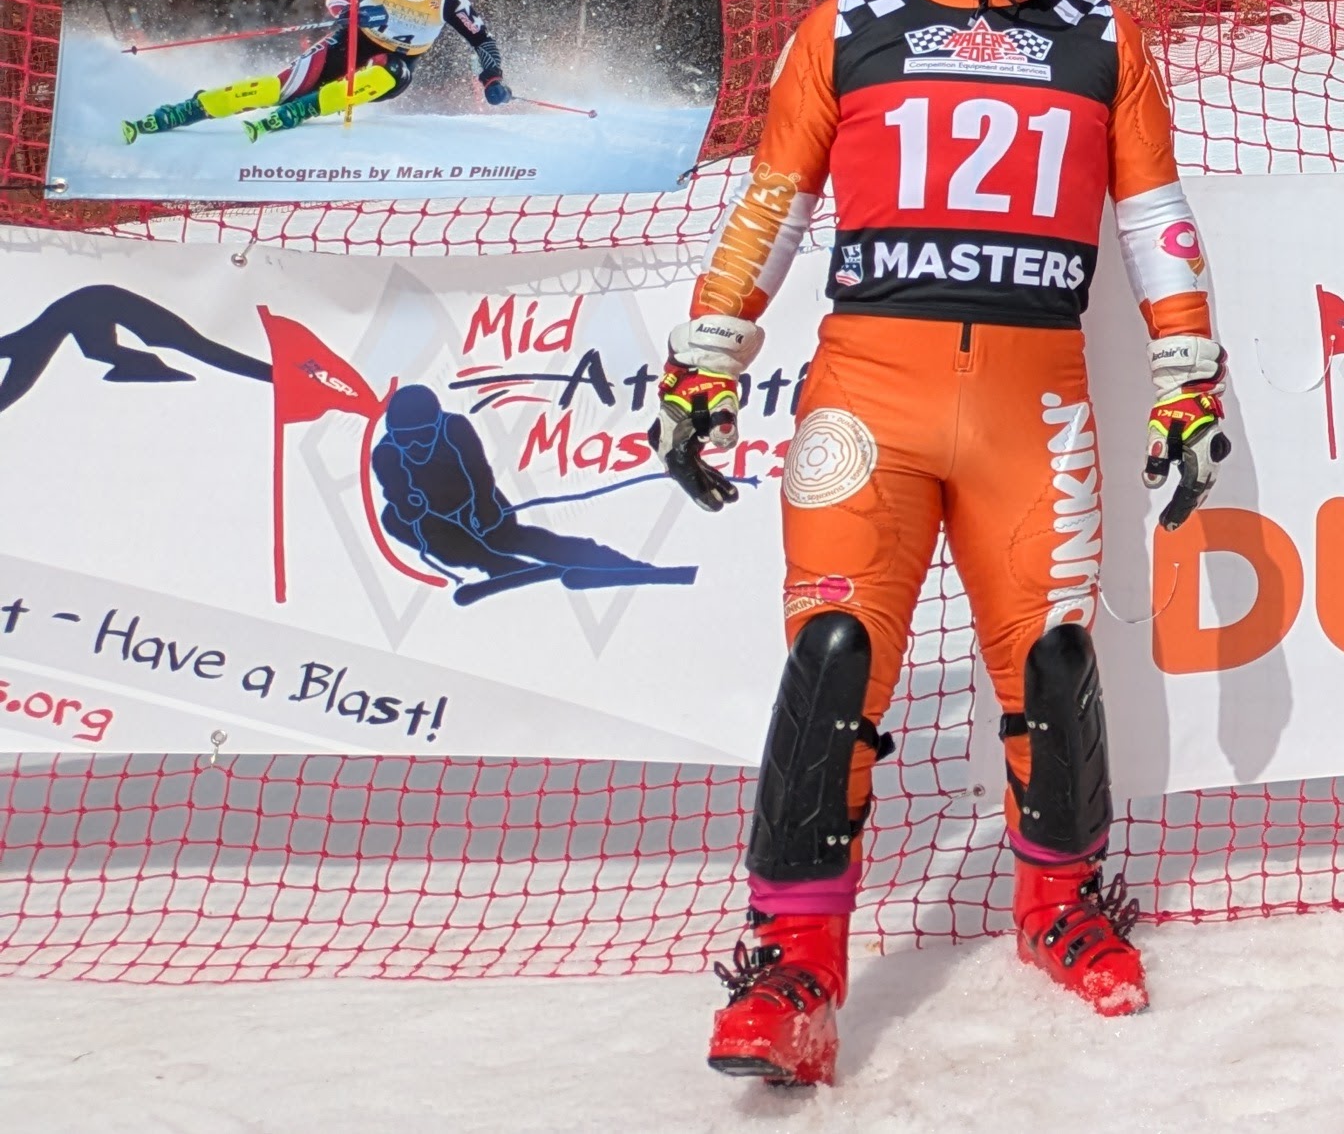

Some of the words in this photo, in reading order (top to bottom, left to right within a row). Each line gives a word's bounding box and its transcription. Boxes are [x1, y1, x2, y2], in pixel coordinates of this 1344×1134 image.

[974, 19, 989, 32] A
[943, 31, 1018, 53] RACERS
[954, 46, 1005, 63] EDGE
[908, 60, 958, 70] Competition
[958, 61, 998, 72] Equipment
[999, 65, 1015, 73] and
[1016, 65, 1048, 76] Services
[884, 96, 1073, 219] 121
[239, 165, 362, 182] photographs
[368, 166, 390, 182] by
[396, 166, 444, 179] Mark
[449, 166, 464, 178] D
[469, 165, 538, 180] Phillips
[872, 240, 1086, 291] MASTERS
[462, 293, 584, 361] Mid
[695, 323, 735, 340] Auclair
[682, 380, 727, 396] LEKI
[1157, 409, 1196, 422] LEKI
[94, 609, 227, 680] Have
[242, 665, 276, 699] a
[288, 661, 449, 743] Blast!
